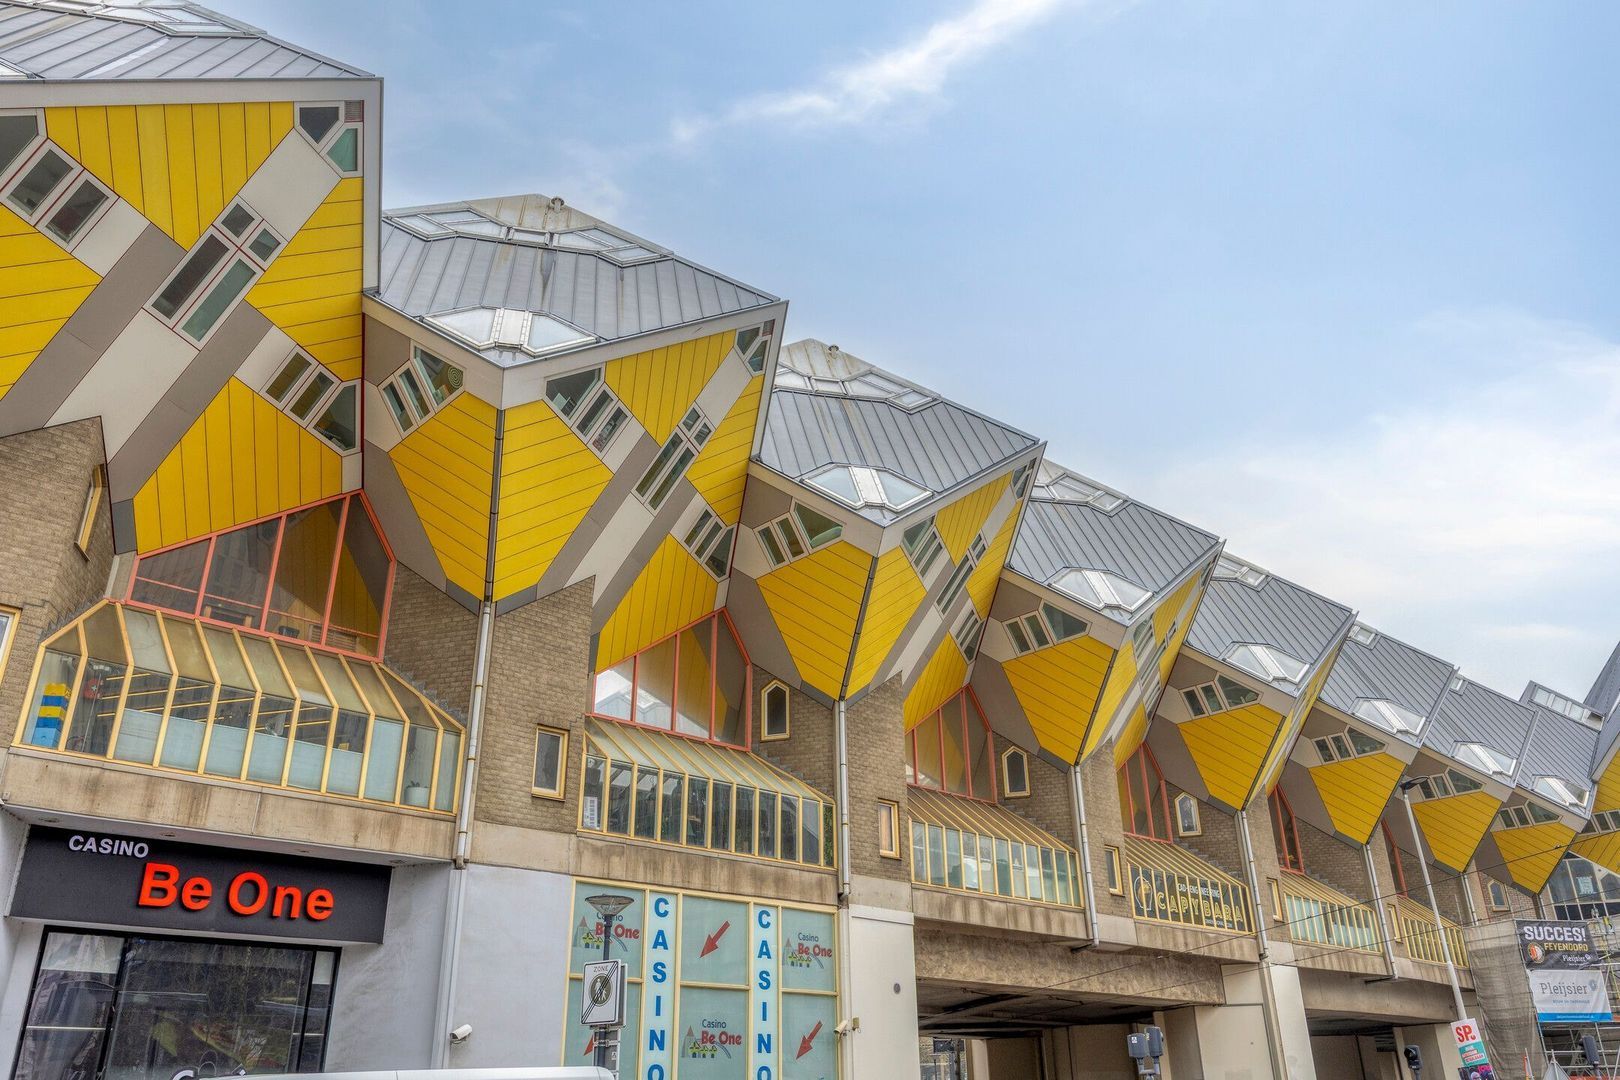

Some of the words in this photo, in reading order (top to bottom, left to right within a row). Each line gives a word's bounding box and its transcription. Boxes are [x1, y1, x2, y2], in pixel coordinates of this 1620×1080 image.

[68, 834, 149, 859] CASINO
[138, 862, 213, 911] Be
[228, 871, 334, 921] One
[1156, 891, 1244, 922] CAPYBARA
[614, 924, 640, 939] One
[798, 932, 819, 942] Casino
[1523, 926, 1586, 942] SUCCES!
[798, 942, 810, 955] Be
[813, 944, 833, 957] One
[1544, 942, 1588, 951] FEYENOORD
[593, 965, 608, 973] ZONE
[646, 897, 669, 1080] CASINO
[757, 909, 772, 1080] CASINO
[1540, 981, 1588, 997] Pleijsier
[701, 1019, 727, 1029] Casino
[701, 1030, 716, 1045] Be
[719, 1031, 742, 1045] One
